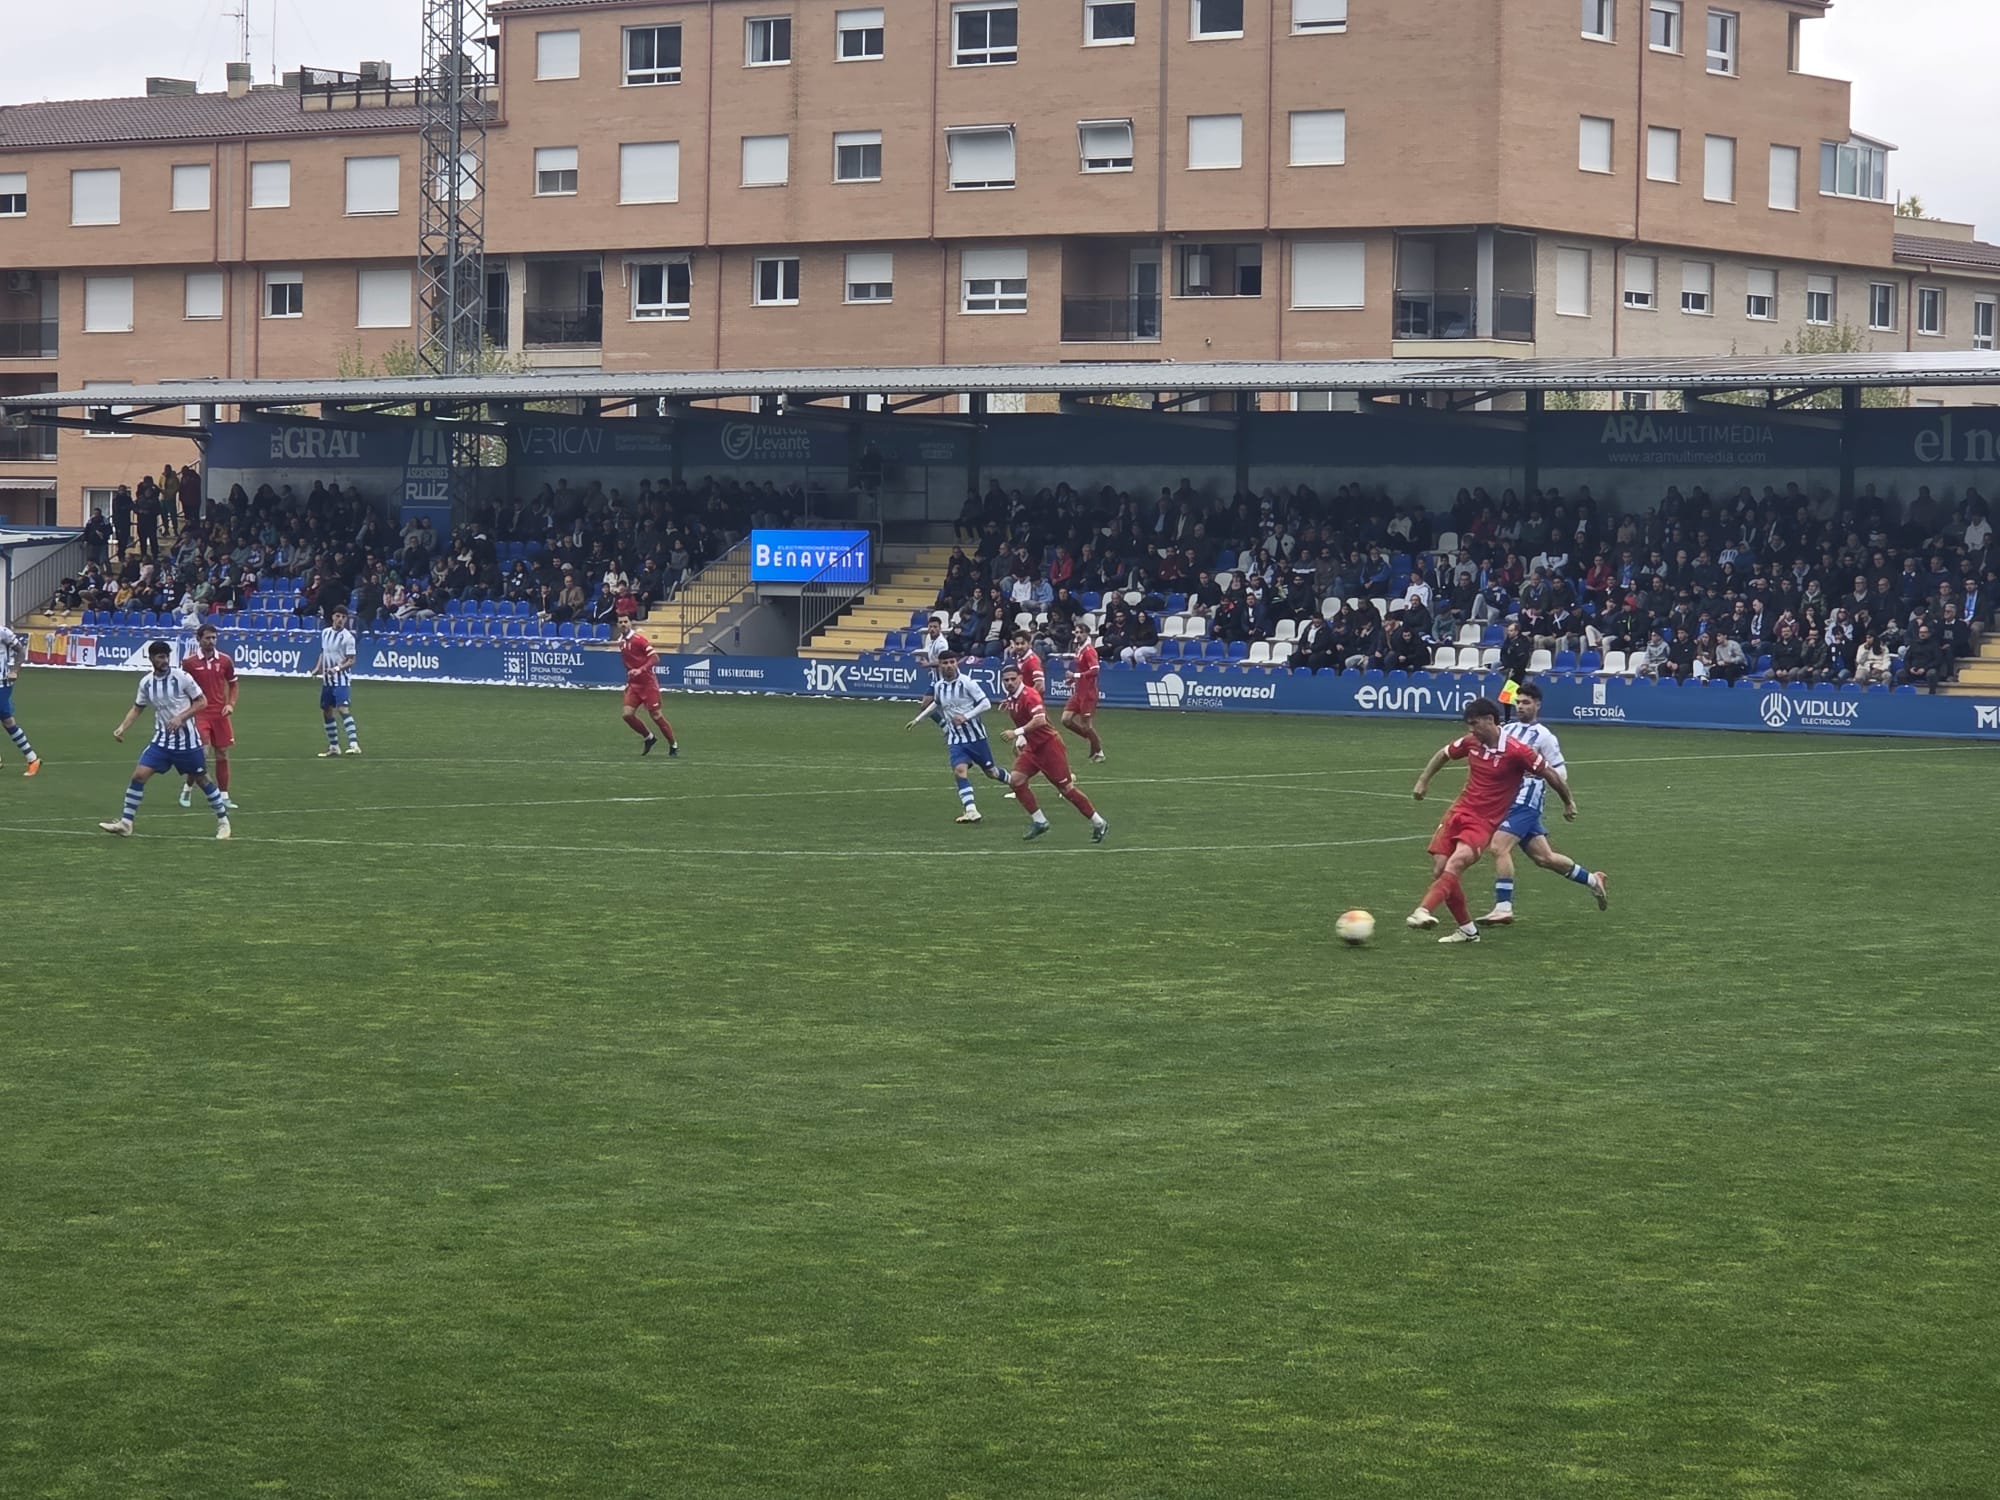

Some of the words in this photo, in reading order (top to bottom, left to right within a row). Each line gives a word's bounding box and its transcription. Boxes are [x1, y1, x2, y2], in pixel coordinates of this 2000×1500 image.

[754, 436, 810, 450] Levante
[1914, 413, 1955, 462] el
[234, 644, 301, 669] Digicopy
[387, 650, 439, 672] Replus
[530, 651, 585, 666] INGEPAL
[817, 664, 847, 692] DK
[847, 666, 917, 683] SYSTEM
[1186, 681, 1276, 699] Tecnovasol
[1354, 685, 1431, 713] erum
[1573, 705, 1626, 719] GESTORÍA
[1793, 700, 1859, 718] VIDLUX
